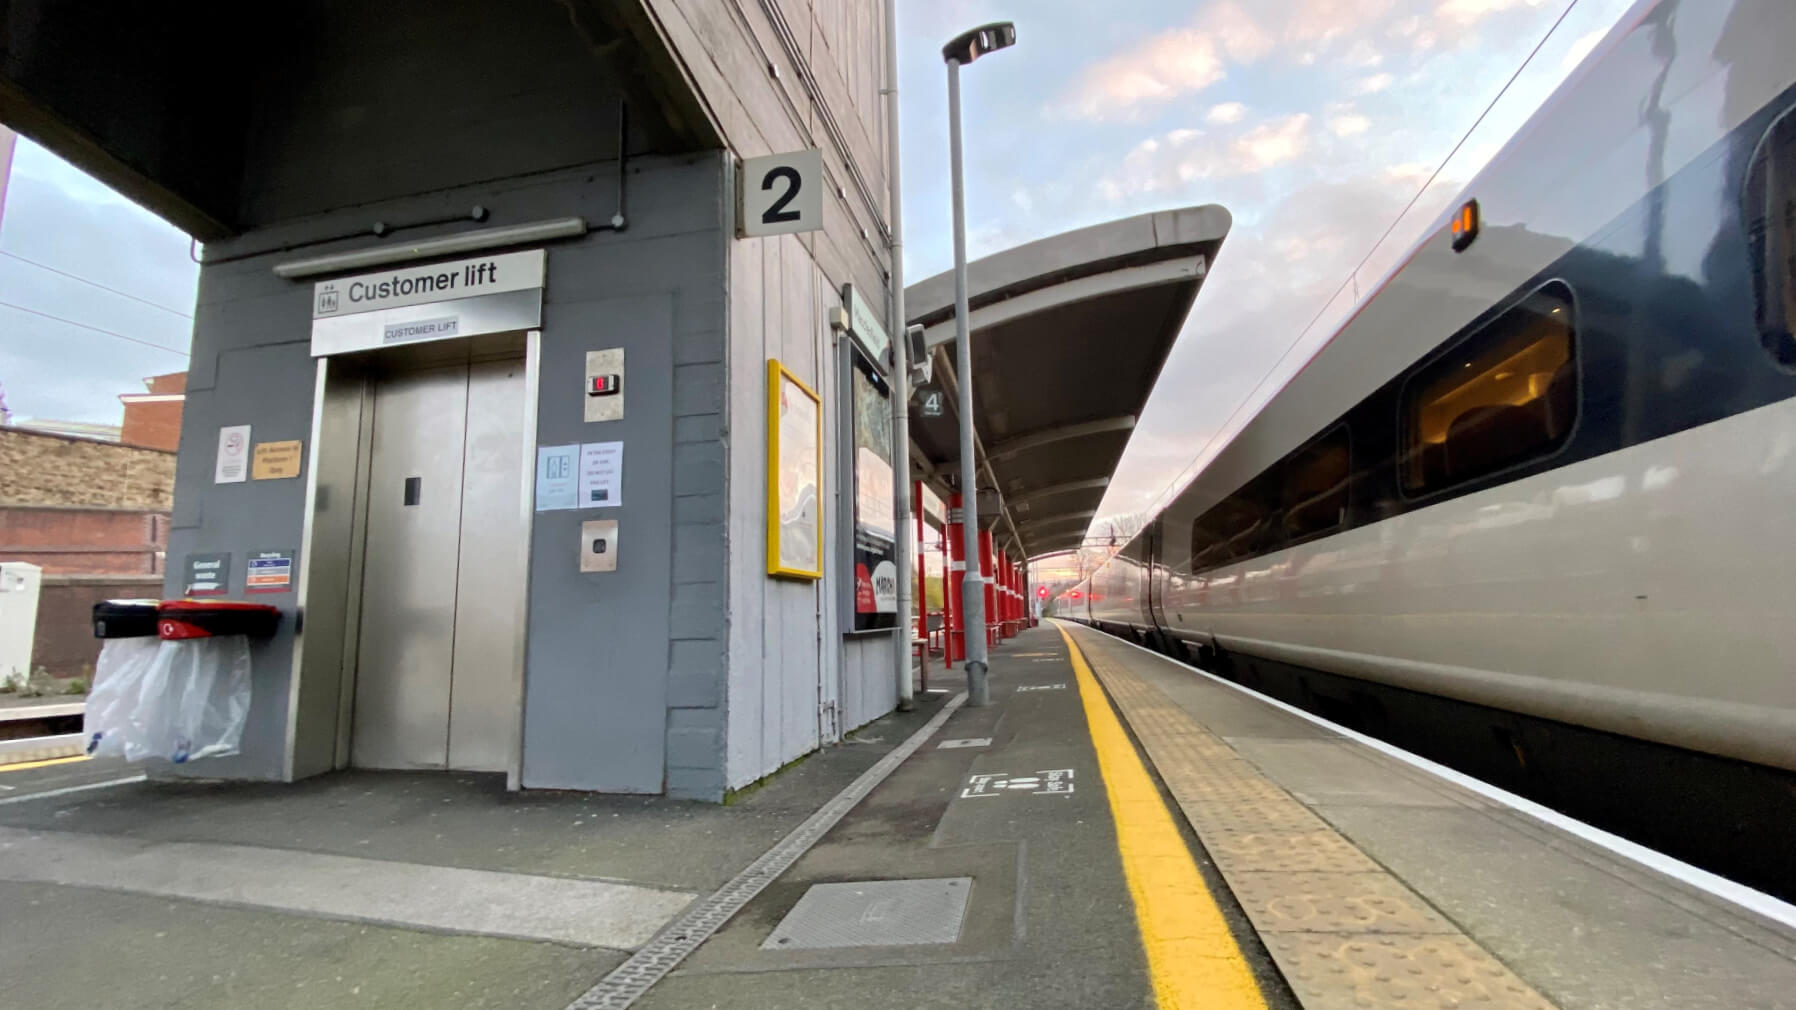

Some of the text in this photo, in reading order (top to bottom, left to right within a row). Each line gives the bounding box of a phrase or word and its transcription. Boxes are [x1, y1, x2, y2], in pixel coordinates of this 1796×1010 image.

[761, 166, 802, 225] 2
[349, 262, 497, 303] Customer lift
[384, 321, 457, 340] CUSTOMER LIFT
[924, 393, 939, 411] 4
[193, 560, 221, 570] General
